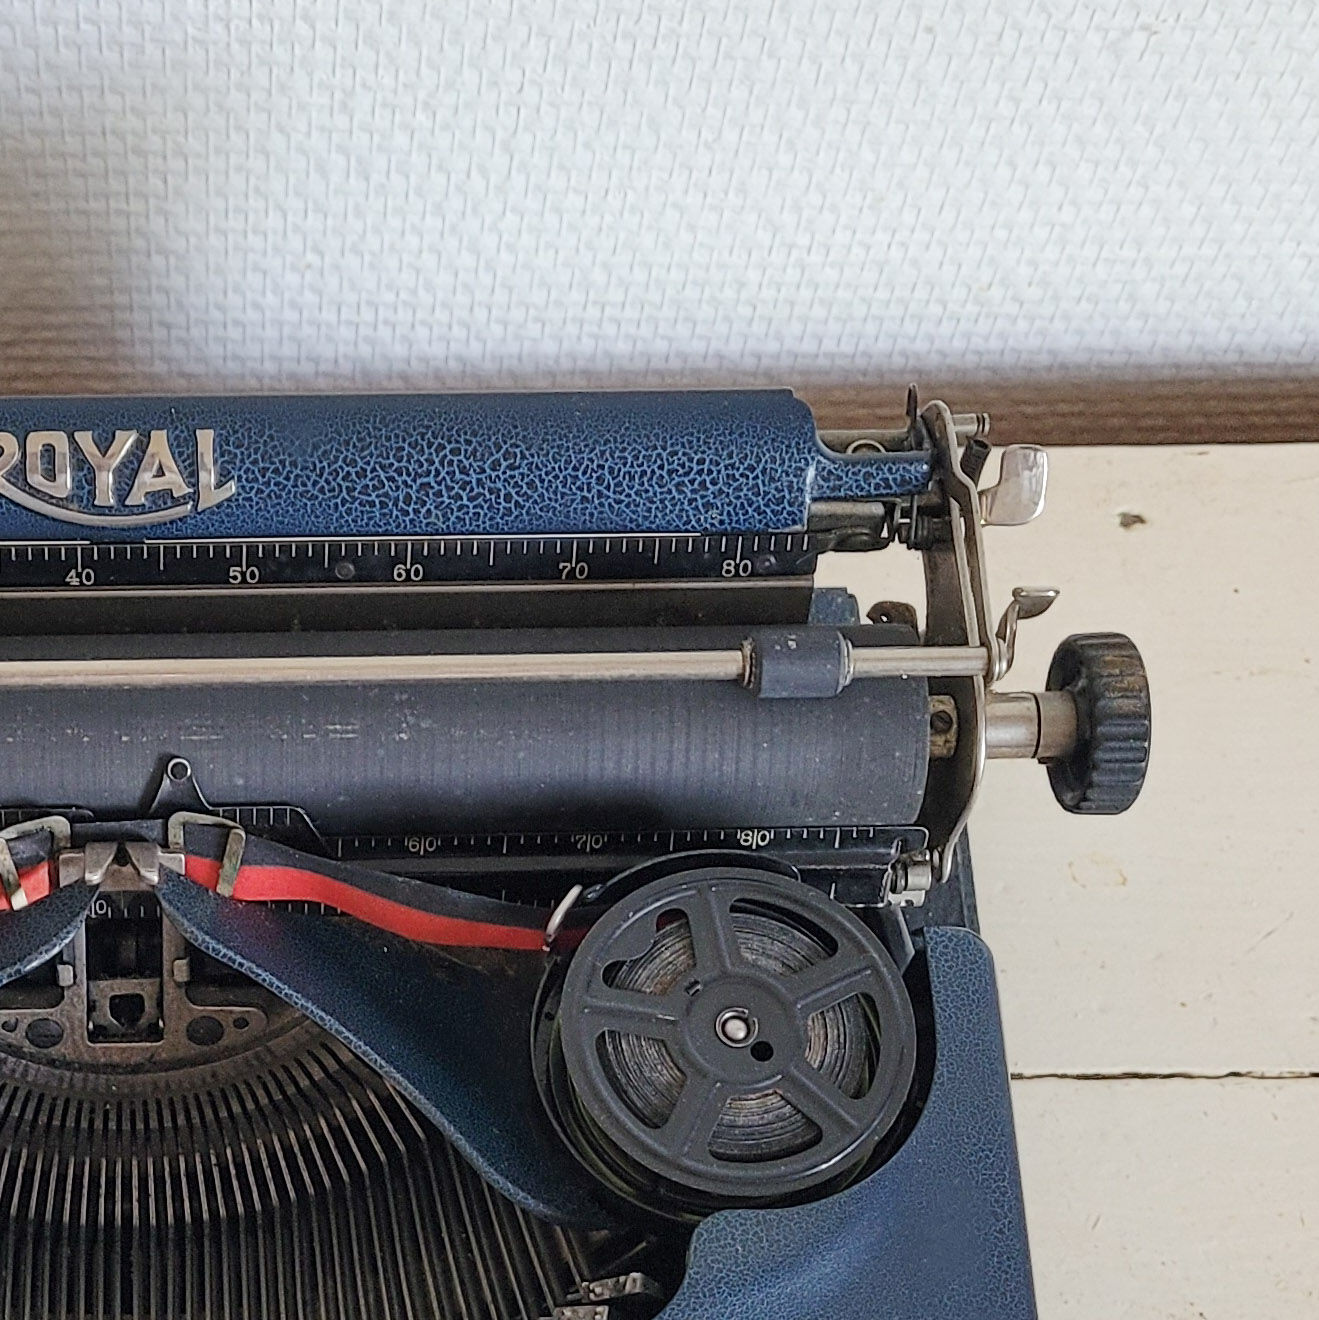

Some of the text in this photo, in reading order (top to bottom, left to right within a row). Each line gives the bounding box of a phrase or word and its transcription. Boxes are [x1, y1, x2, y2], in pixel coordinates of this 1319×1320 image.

[64, 567, 95, 587] 40
[228, 566, 260, 584] 50
[392, 564, 424, 581] 60
[558, 562, 589, 580] 70
[721, 560, 752, 578] 80
